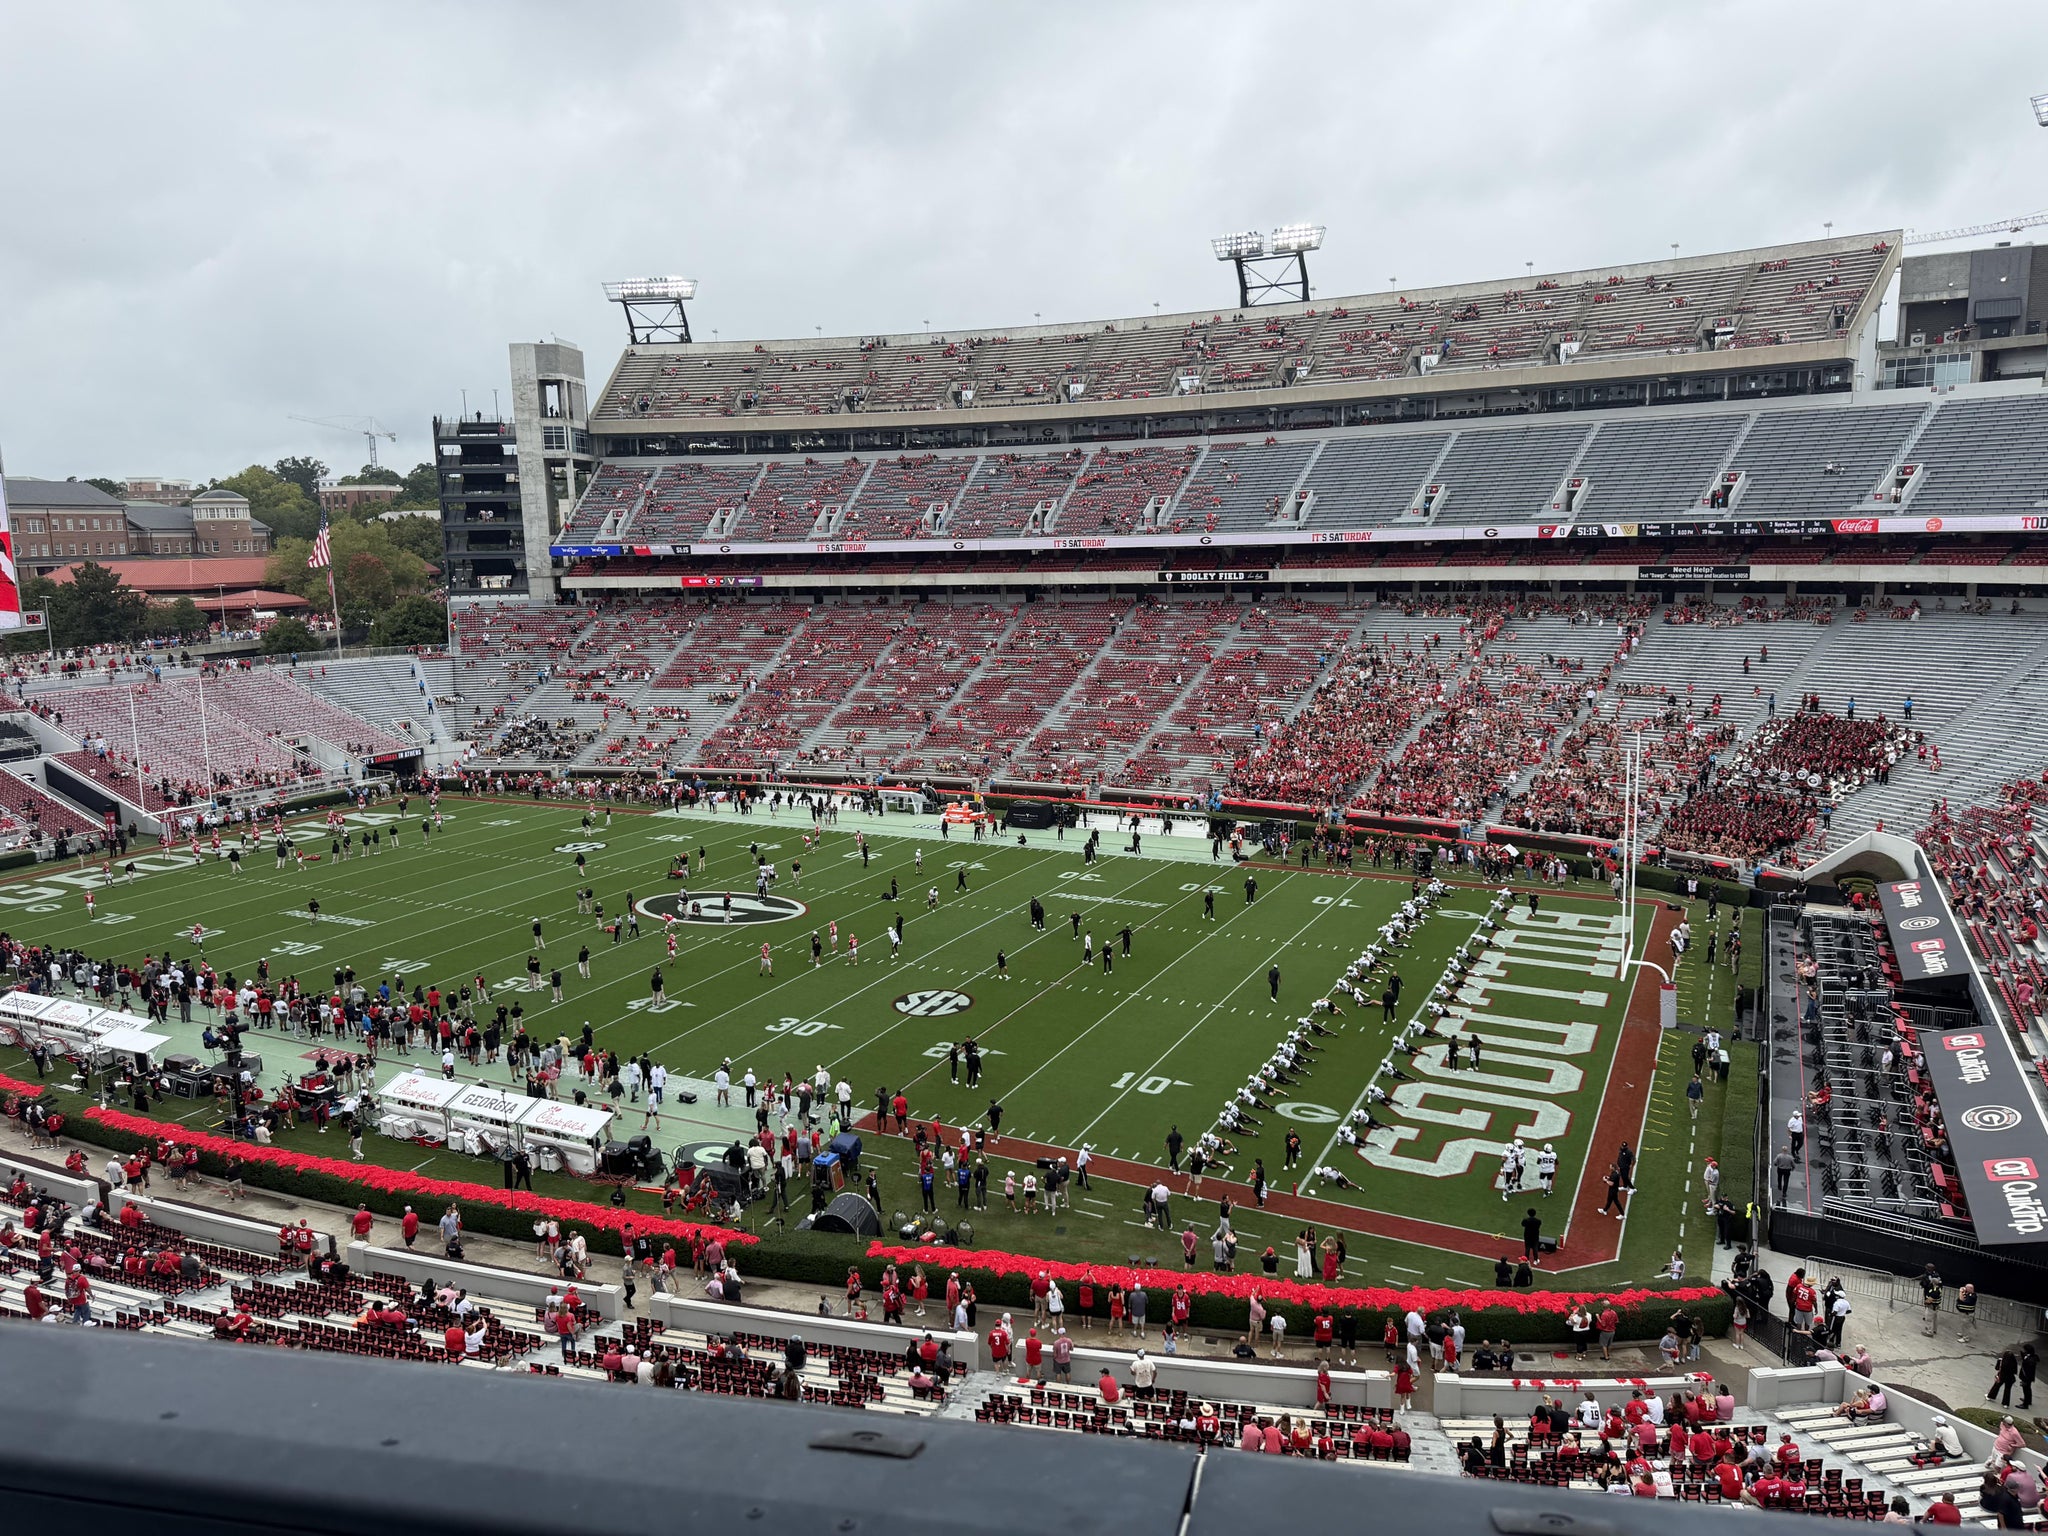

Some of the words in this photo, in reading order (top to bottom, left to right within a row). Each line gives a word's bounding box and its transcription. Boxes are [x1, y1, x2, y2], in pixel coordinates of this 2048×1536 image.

[1069, 539, 1106, 547] SATURDAY
[1312, 534, 1327, 542] IT'S
[1329, 532, 1372, 541] SATURDAY
[1219, 572, 1245, 580] FIELD
[1921, 951, 1949, 975] QuikTrip
[895, 990, 971, 1017] SEC
[765, 1016, 828, 1037] 30
[1956, 1048, 1991, 1084] QuikTrip
[1110, 1072, 1174, 1095] 10
[462, 1093, 518, 1115] GEORGIA
[1275, 1102, 1341, 1124] G
[2002, 1181, 2048, 1235] QuikTrip
[1798, 1290, 1809, 1301] 73
[1322, 1320, 1330, 1329] 15
[995, 1336, 1000, 1346] 3
[1590, 1410, 1599, 1421] 19
[1202, 1423, 1214, 1432] 14
